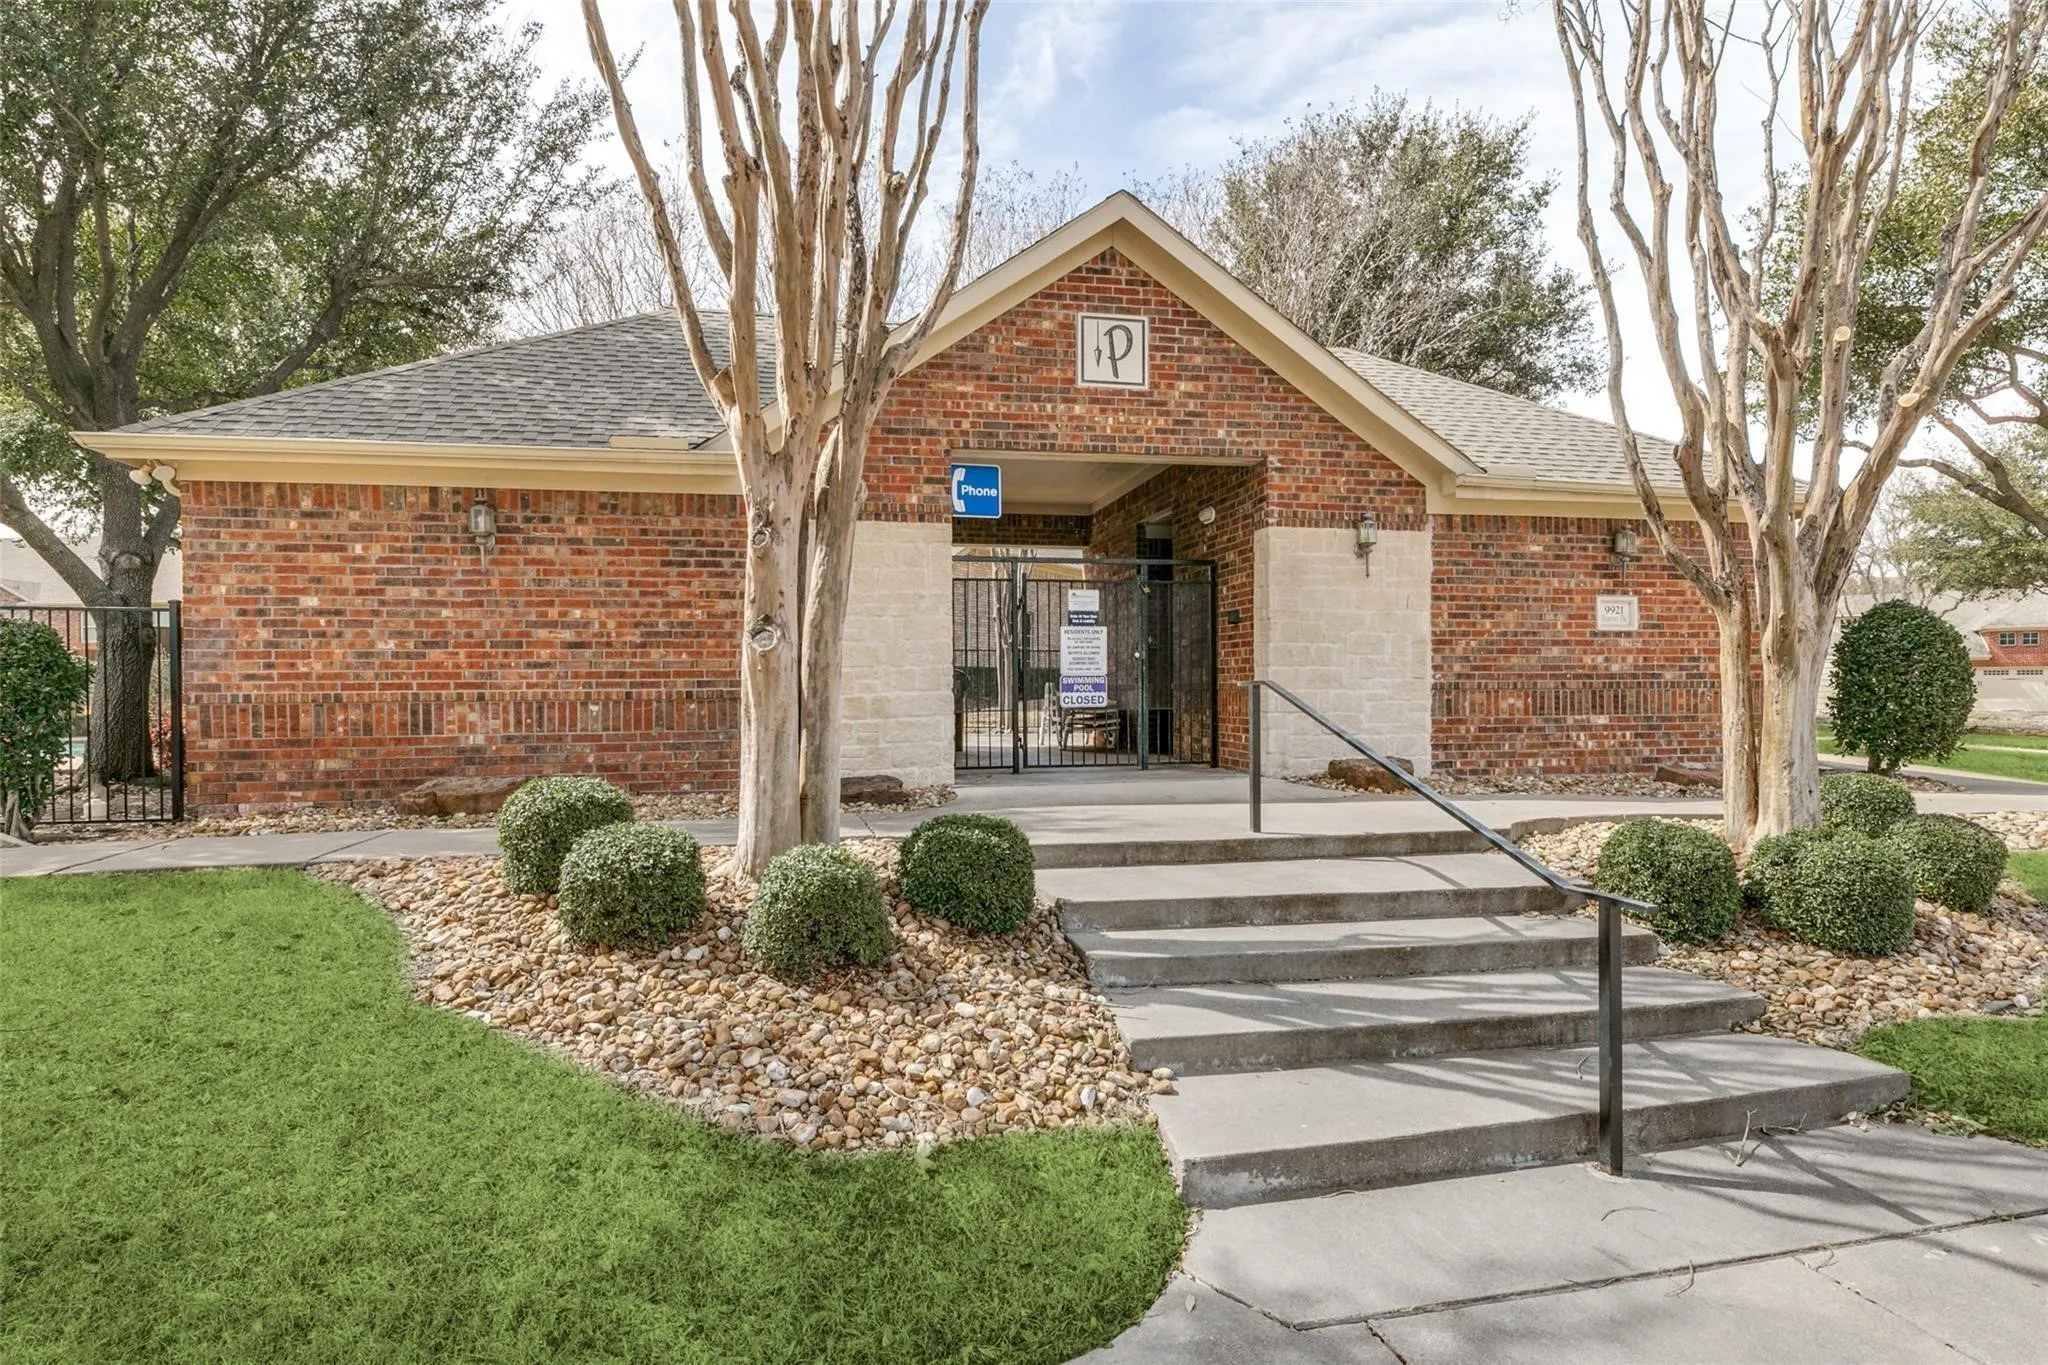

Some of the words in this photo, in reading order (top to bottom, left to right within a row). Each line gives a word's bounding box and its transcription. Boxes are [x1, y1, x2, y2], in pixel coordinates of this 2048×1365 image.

[1103, 324, 1133, 379] P
[961, 484, 998, 497] Phone
[1604, 605, 1624, 615] 9921
[1062, 676, 1105, 684] SWIMMING
[1073, 684, 1094, 692] POOL
[1062, 695, 1105, 705] CLOSED
